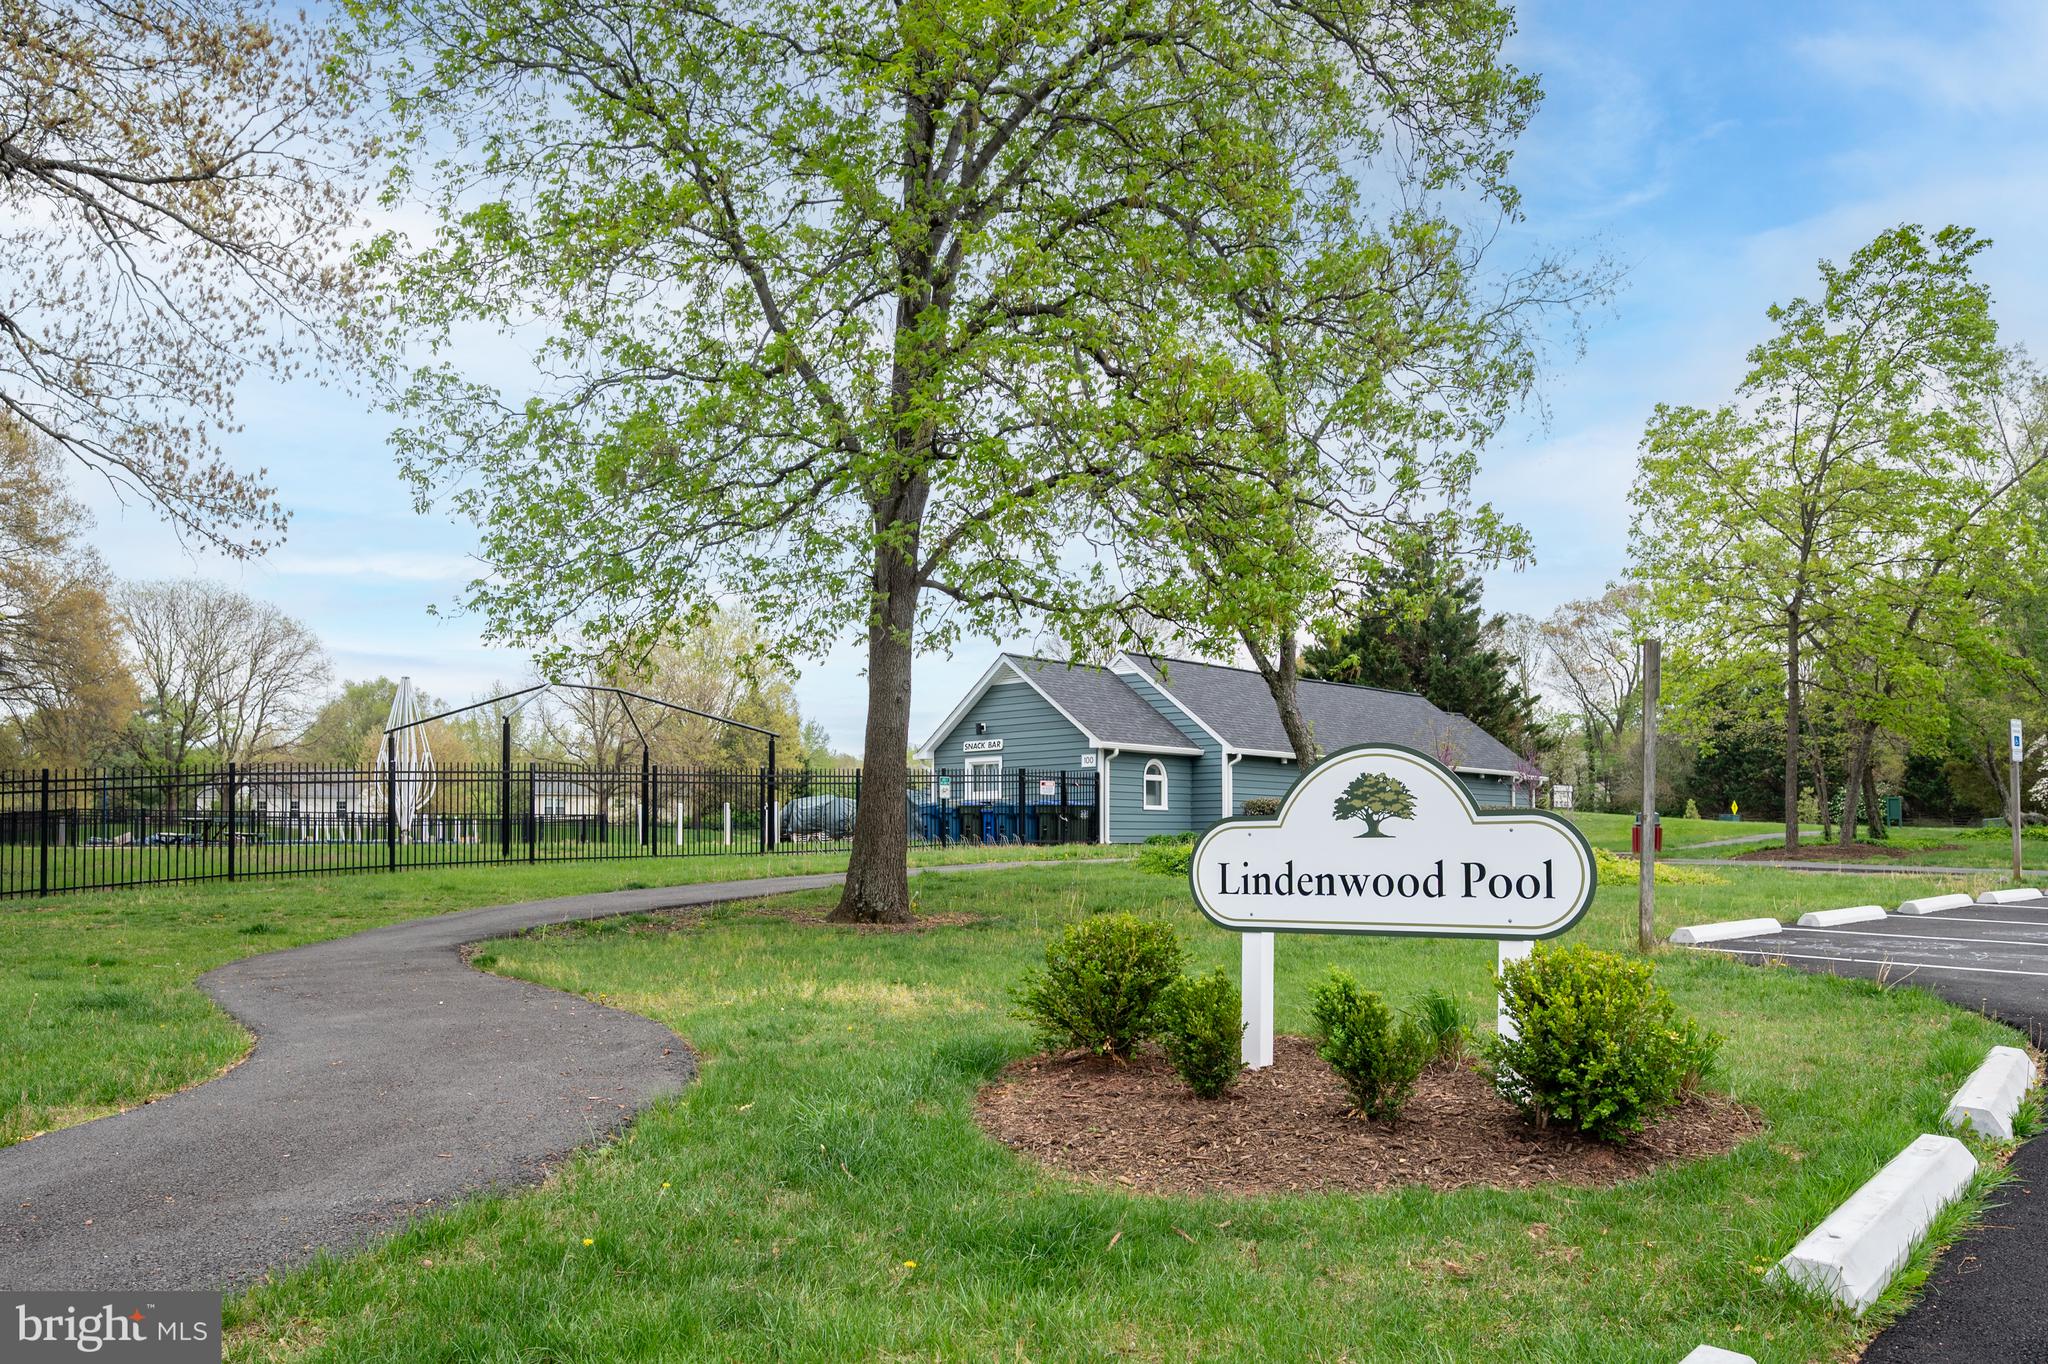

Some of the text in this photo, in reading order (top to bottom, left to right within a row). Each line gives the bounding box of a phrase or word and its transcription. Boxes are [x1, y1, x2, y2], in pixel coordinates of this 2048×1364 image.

[964, 742, 986, 750] SNACK
[1084, 756, 1094, 764] 100
[1217, 858, 1556, 900] Lindenwood Pool
